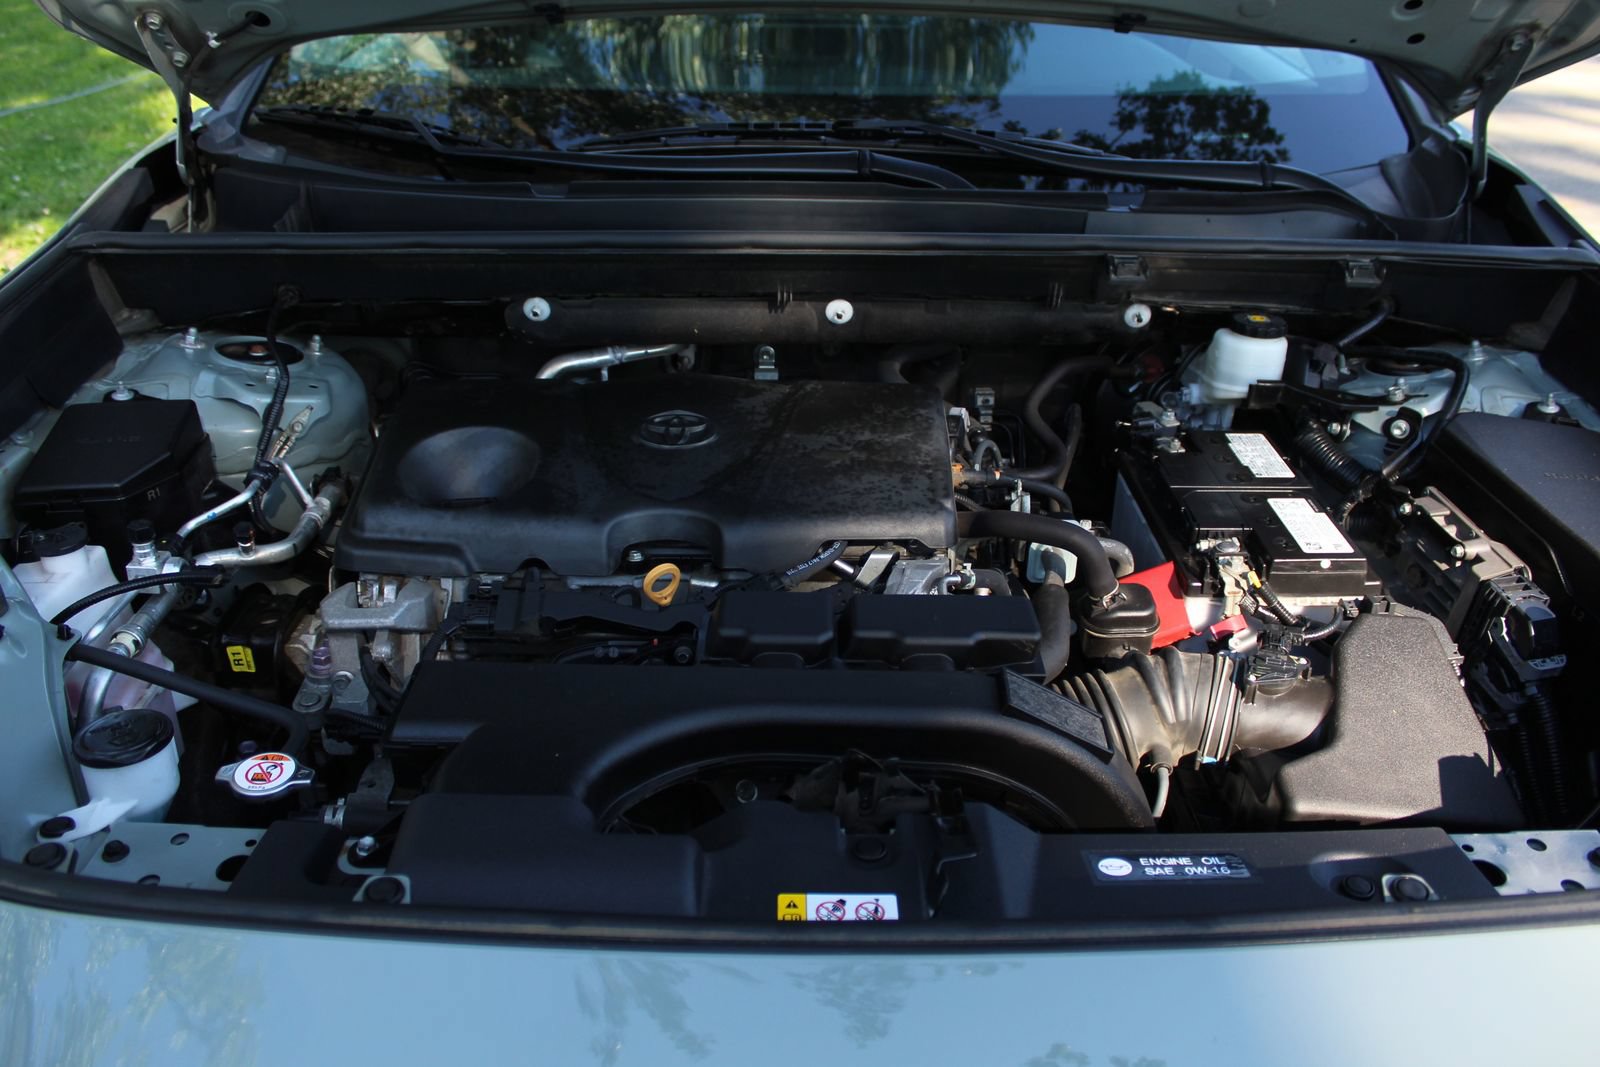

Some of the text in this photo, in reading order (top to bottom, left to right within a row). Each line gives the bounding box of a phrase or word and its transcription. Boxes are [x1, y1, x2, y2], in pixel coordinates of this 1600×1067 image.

[147, 487, 160, 501] R1
[231, 652, 244, 666] R1
[1139, 856, 1226, 866] ENGINE OIL
[1144, 866, 1231, 876] SAE 0W-16
